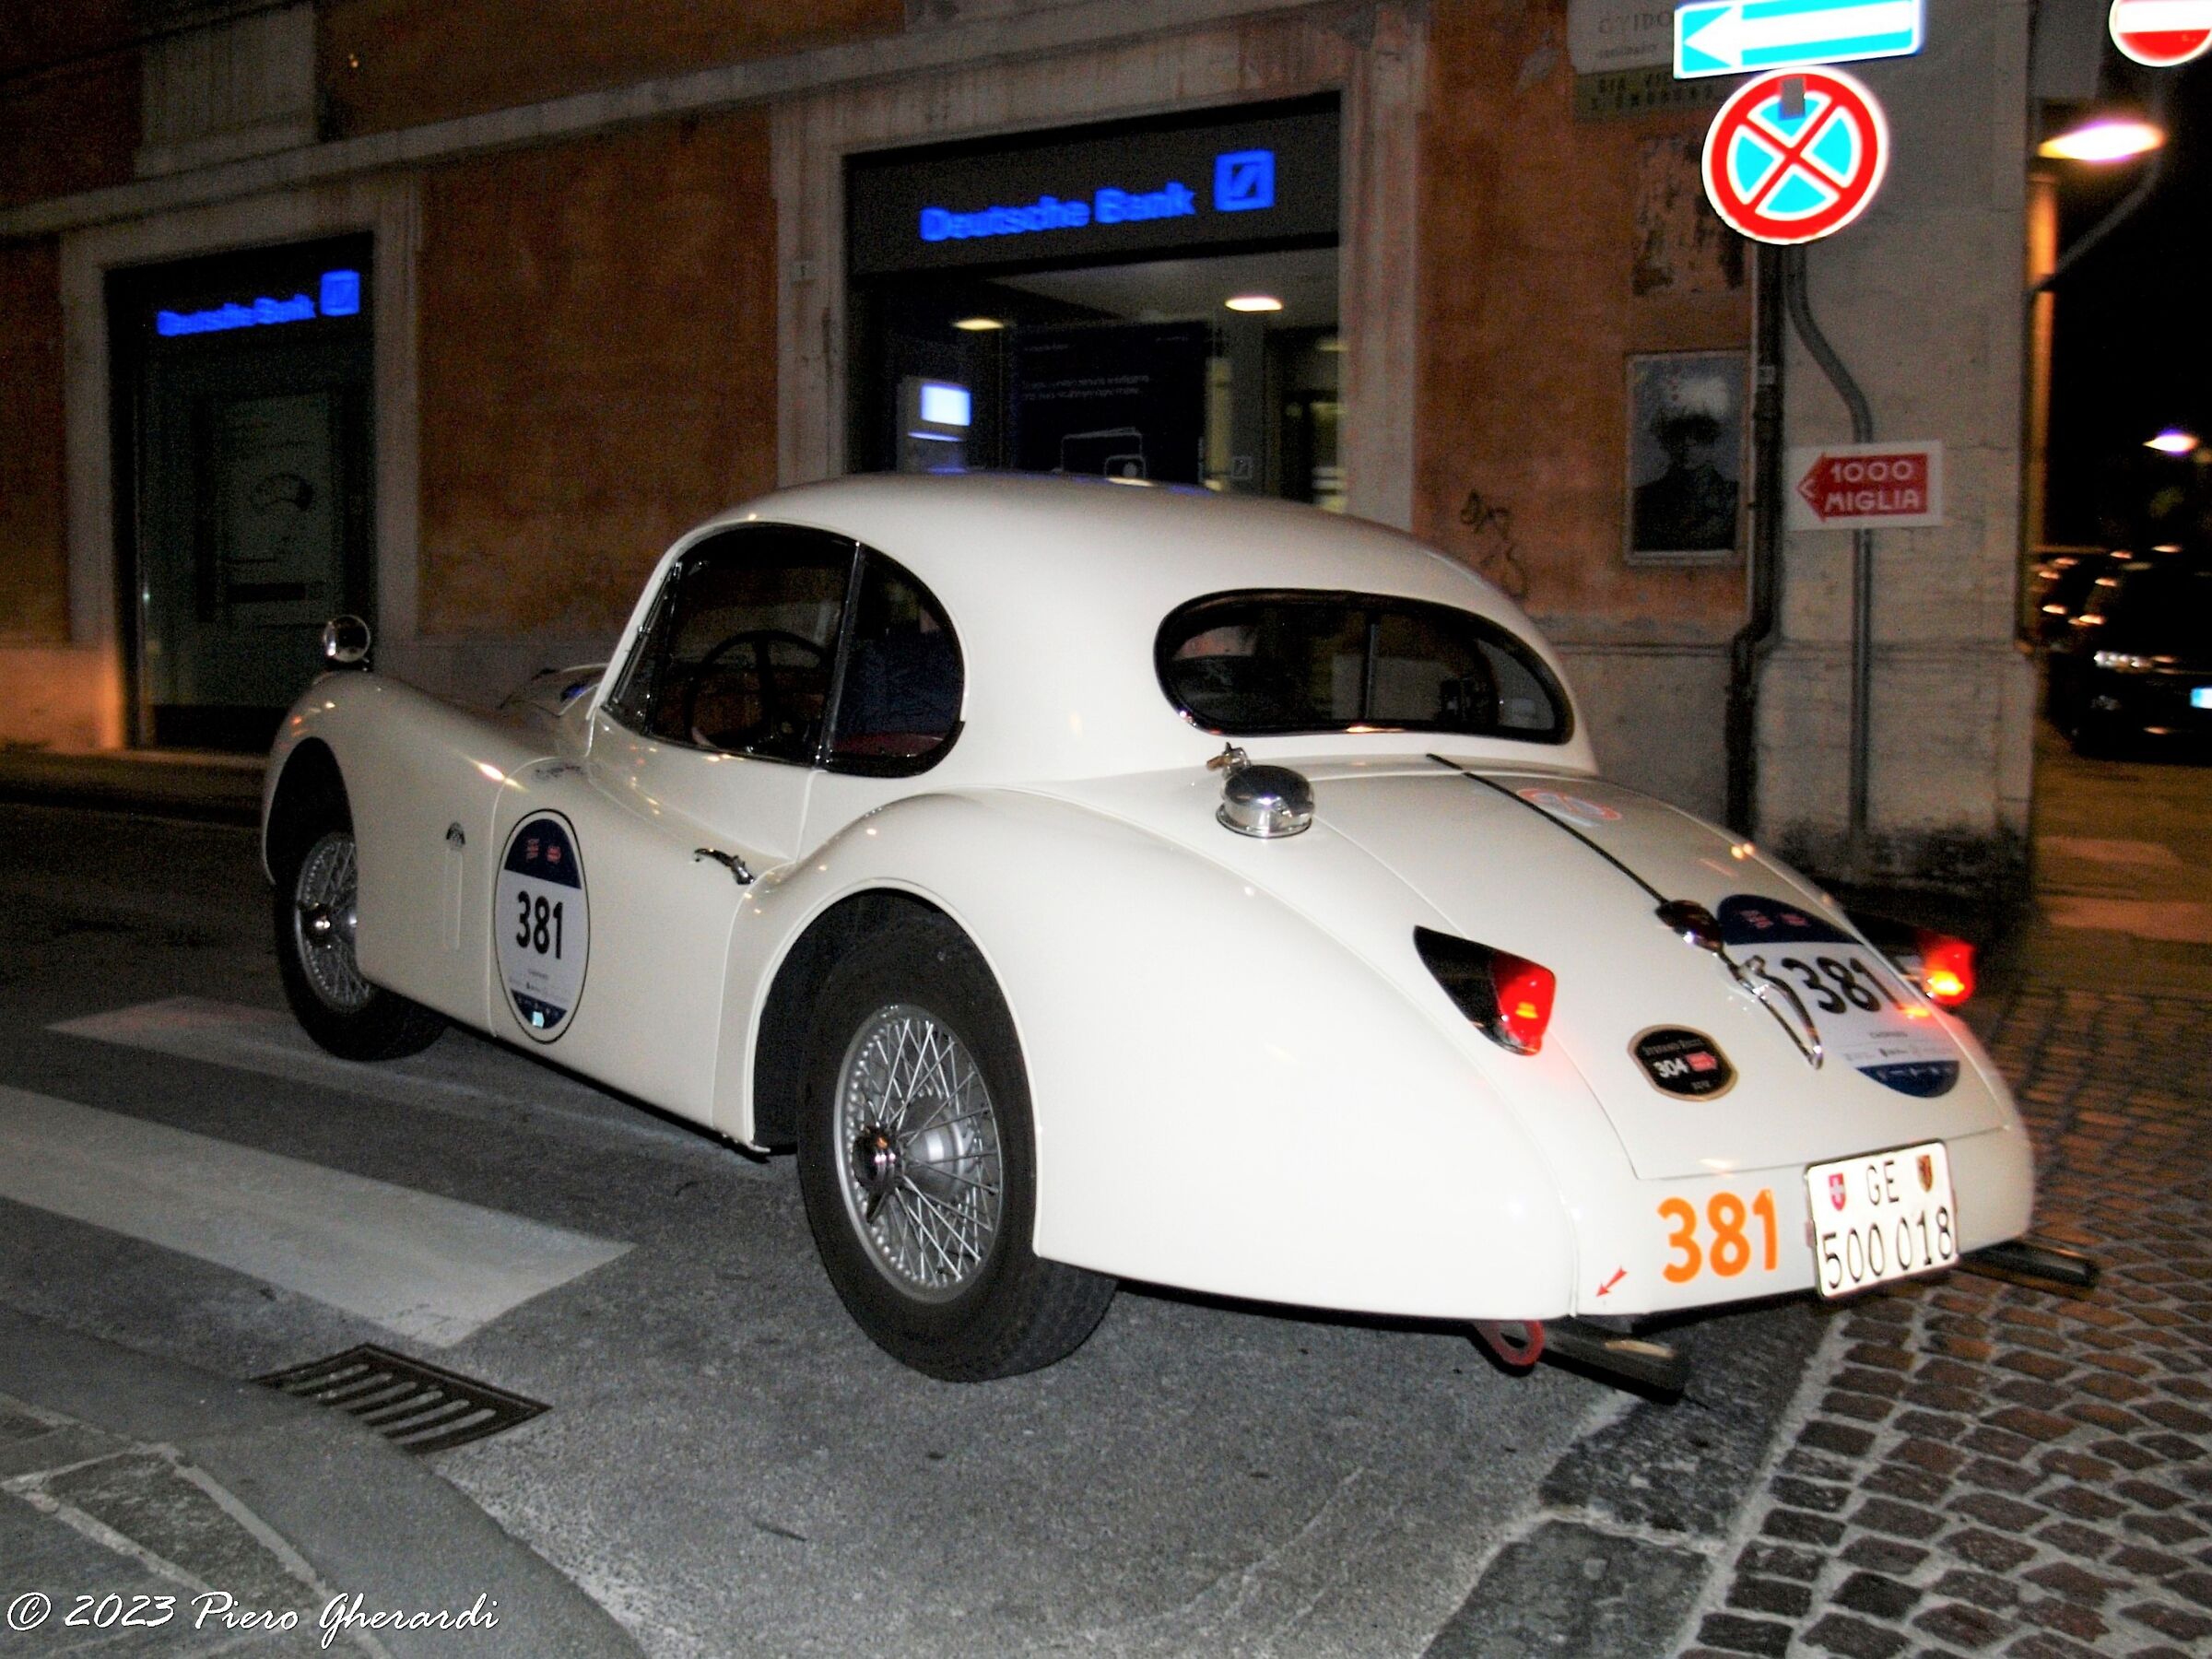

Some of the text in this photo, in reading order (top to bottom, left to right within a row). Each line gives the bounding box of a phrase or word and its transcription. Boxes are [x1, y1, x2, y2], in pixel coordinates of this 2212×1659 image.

[919, 181, 1195, 241] Deutsche Bank
[1824, 488, 1919, 512] MIGLIA
[1830, 461, 1912, 483] 1000
[516, 890, 564, 959] 381
[1781, 956, 1904, 1014] 381
[1653, 1057, 1688, 1078] 304
[1865, 1159, 1900, 1206] GE
[1656, 1187, 1779, 1284] 381
[1821, 1206, 1953, 1289] 500 018
